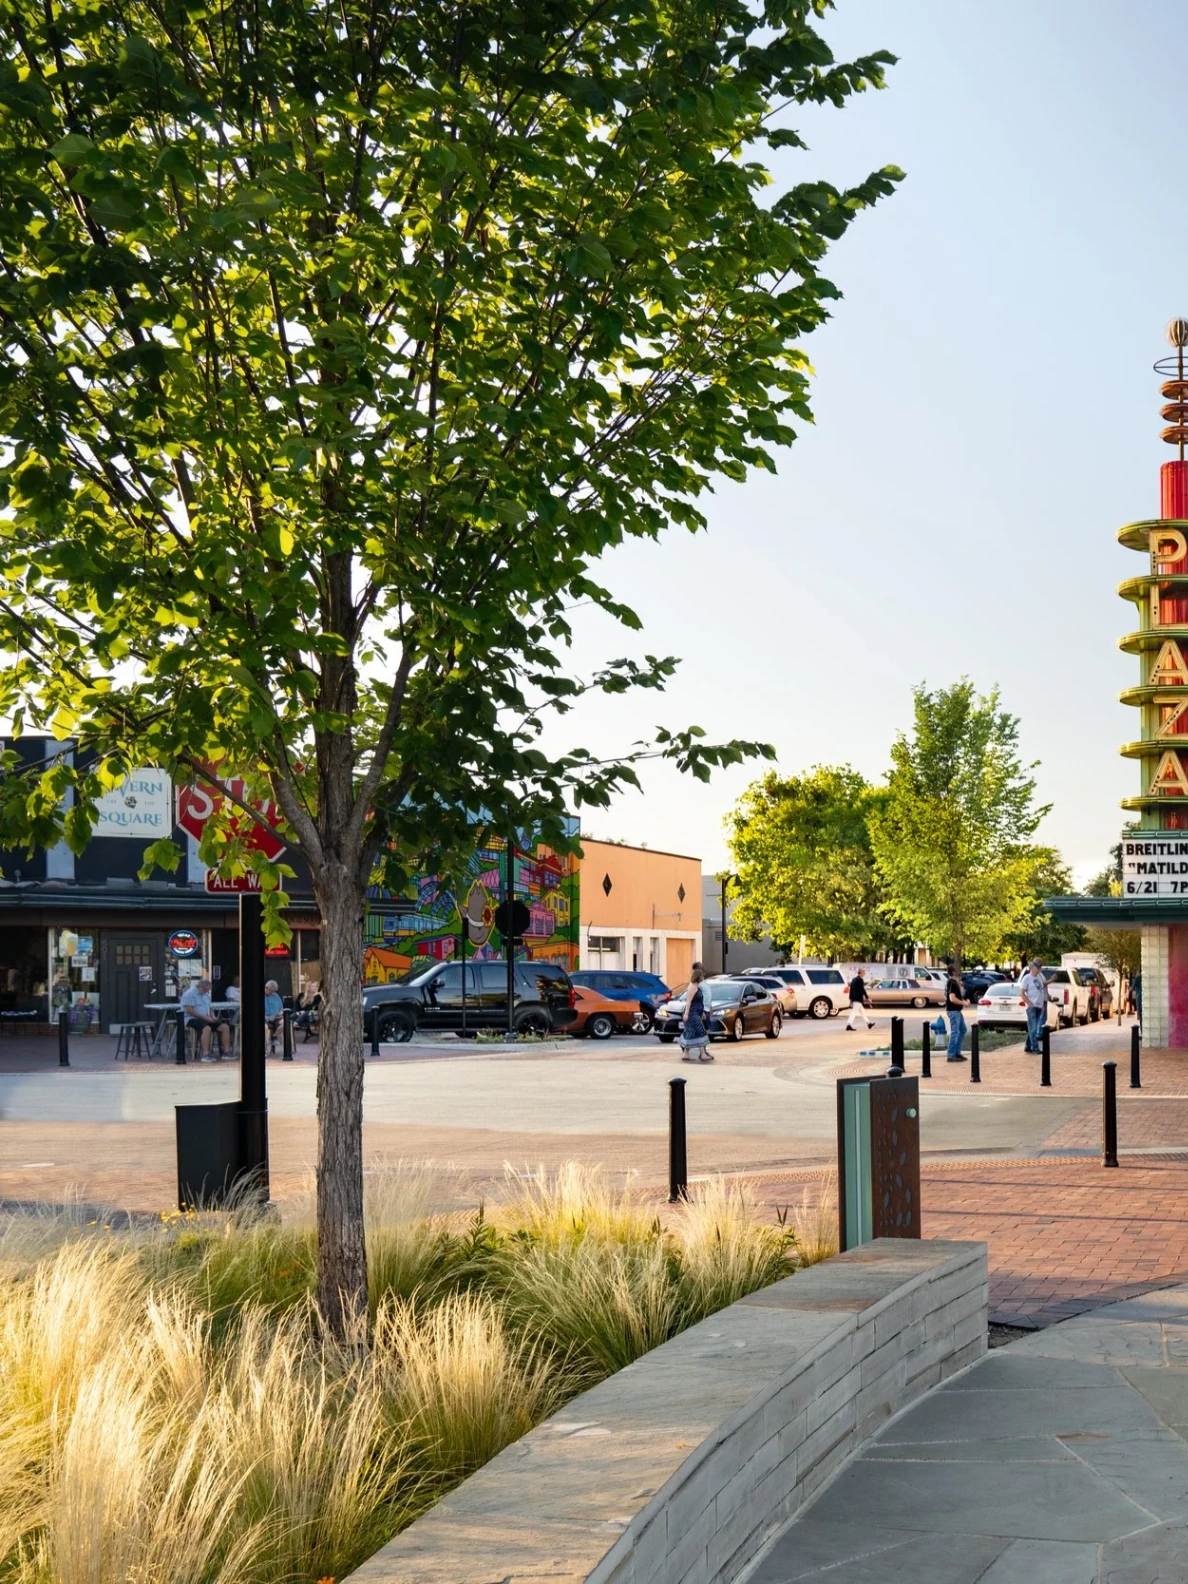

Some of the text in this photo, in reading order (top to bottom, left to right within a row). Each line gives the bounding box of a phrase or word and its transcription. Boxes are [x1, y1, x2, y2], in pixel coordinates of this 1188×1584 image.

[120, 778, 162, 797] VERN
[186, 772, 283, 819] ST
[100, 811, 162, 827] SQUARE
[213, 873, 238, 888] ALL
[1127, 881, 1158, 894] 6/21
